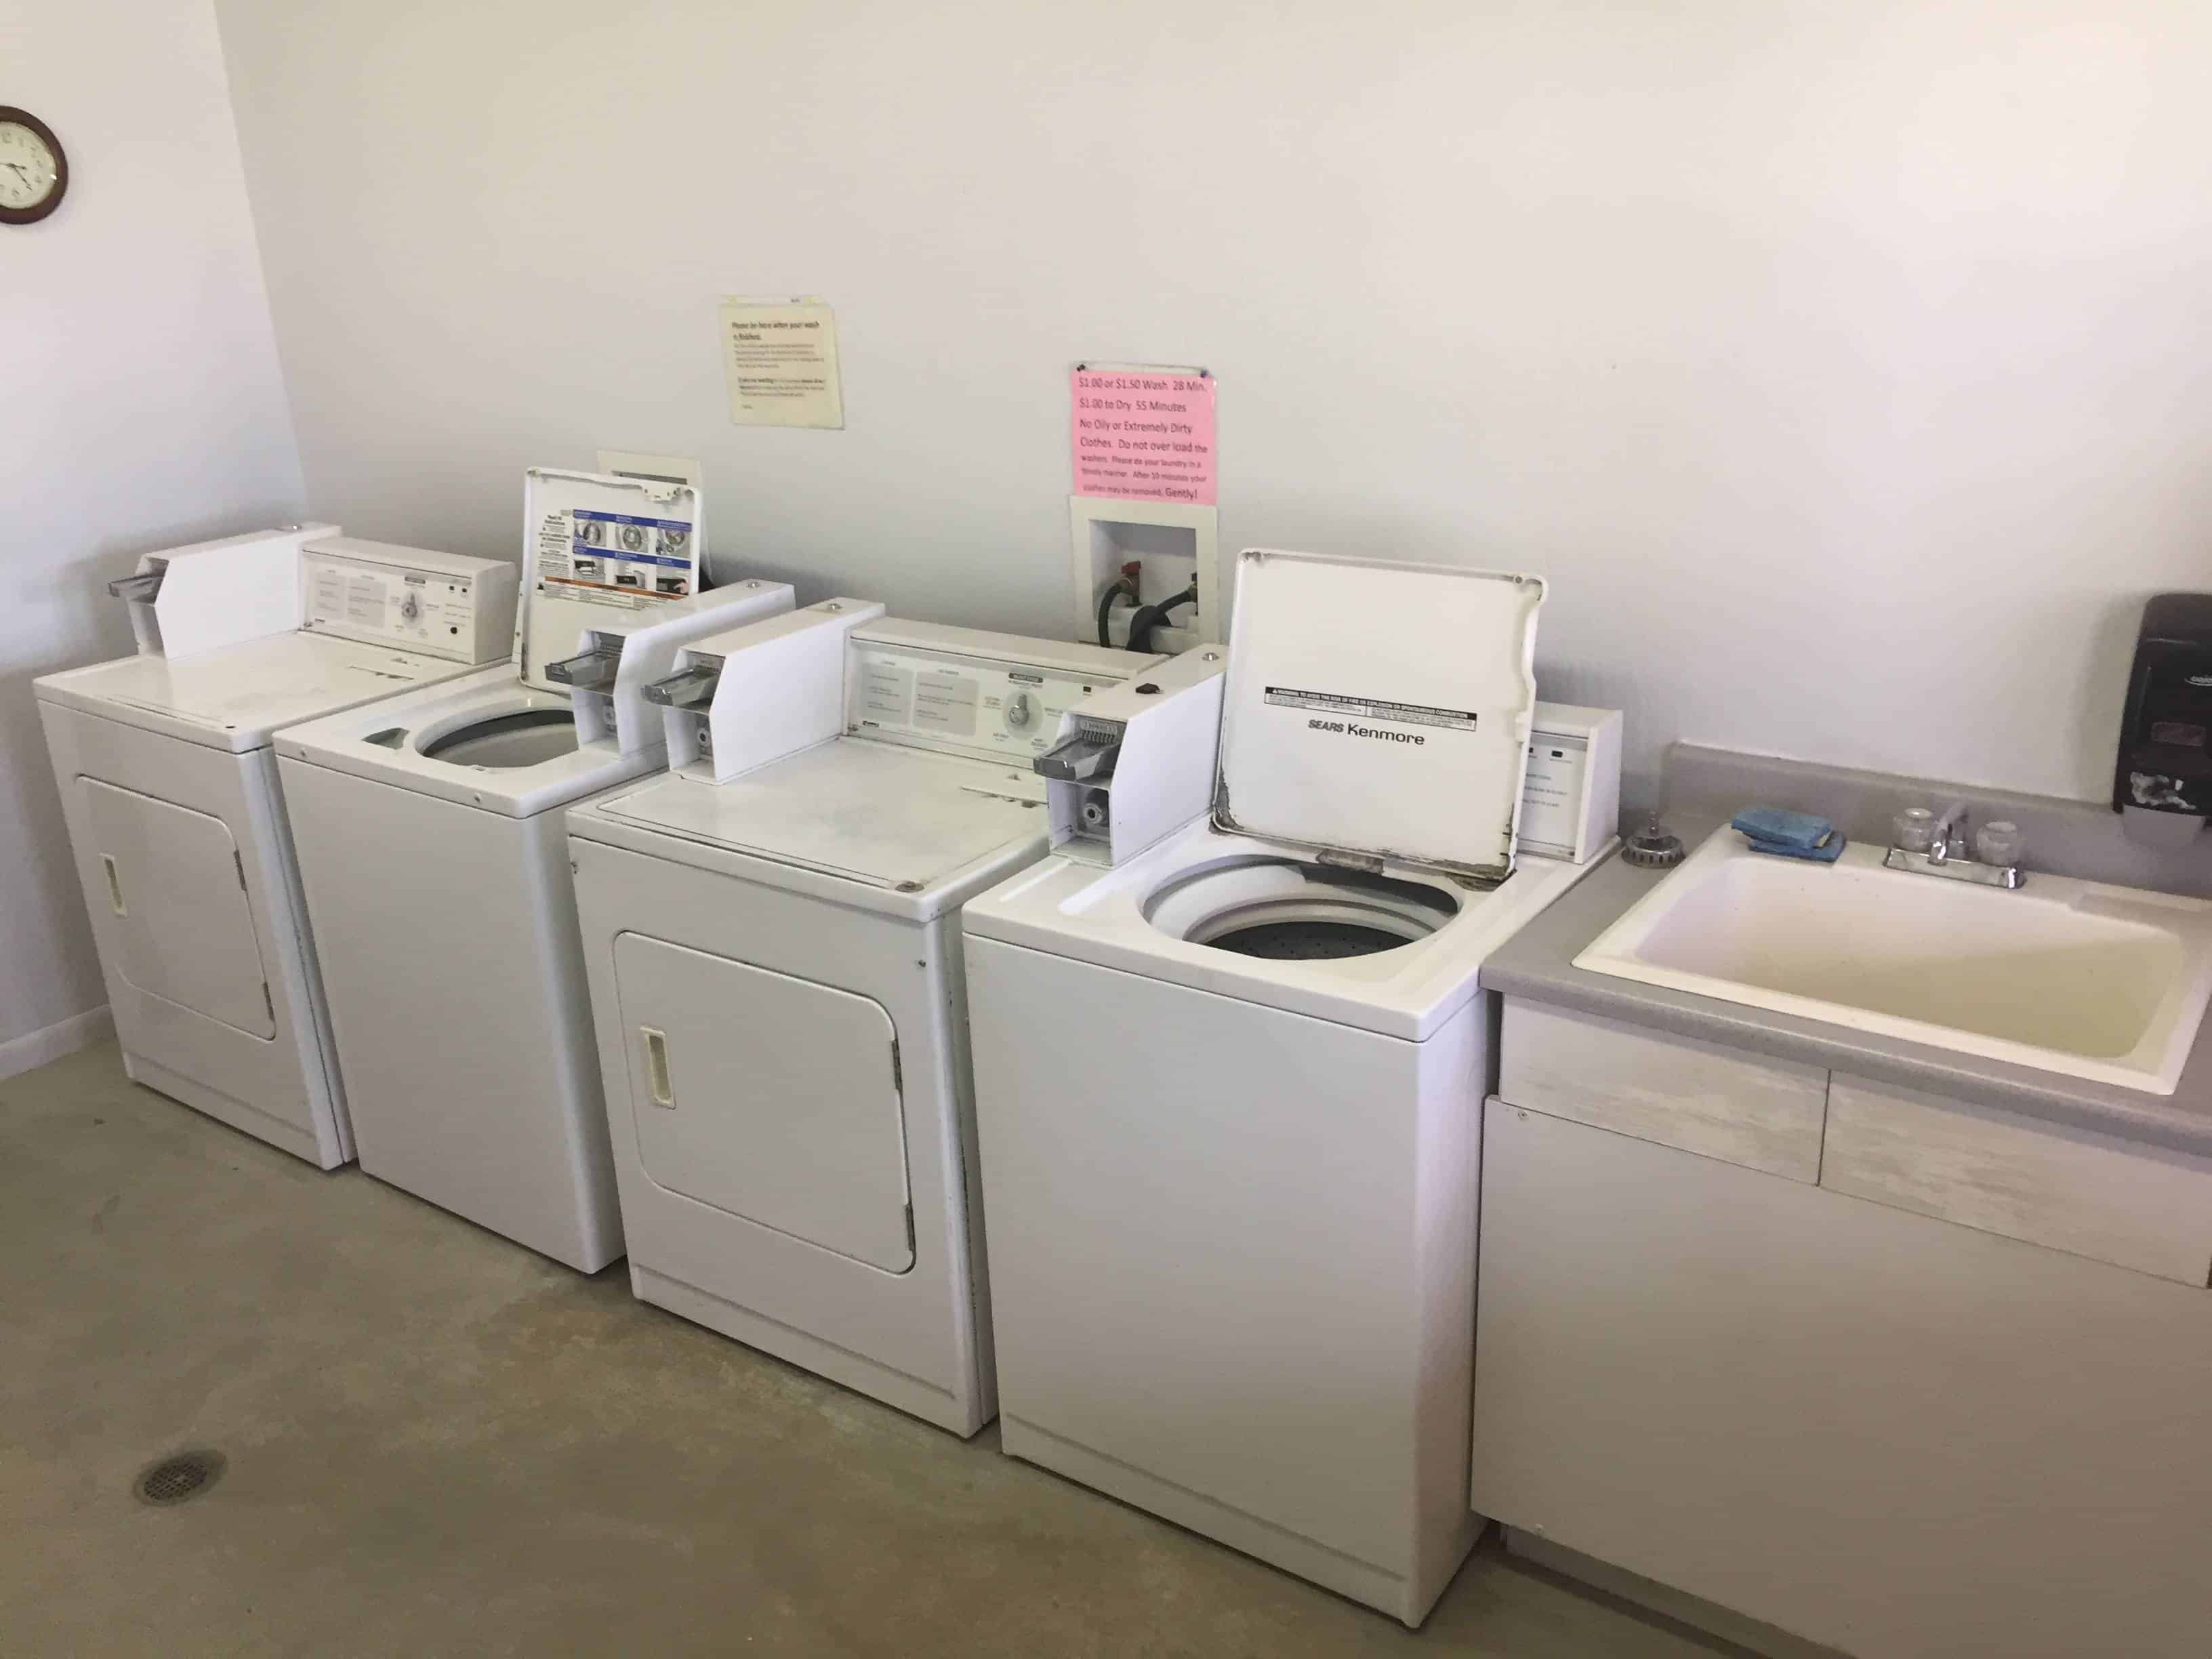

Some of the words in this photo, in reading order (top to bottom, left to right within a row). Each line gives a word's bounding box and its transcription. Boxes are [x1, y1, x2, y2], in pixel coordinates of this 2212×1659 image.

[1079, 377, 1103, 388] $1.00
[1116, 378, 1141, 390] $1.50
[1143, 380, 1168, 390] Wash
[1173, 381, 1184, 391] 28
[1187, 382, 1206, 392] Min.
[1080, 398, 1103, 409] $1.00
[1105, 401, 1114, 409] to
[1116, 400, 1132, 411] Dry
[1136, 401, 1147, 411] 55
[1150, 402, 1187, 413] Minutes
[1080, 419, 1091, 428] No
[1094, 419, 1110, 431] Oily
[1124, 422, 1168, 433] Extremely
[1171, 423, 1192, 435] Dirty
[1119, 439, 1130, 449] Do
[1133, 441, 1147, 450] not
[1173, 443, 1192, 453] load
[1195, 444, 1207, 453] the
[1112, 456, 1132, 464] Please
[1161, 459, 1186, 468] laundry
[1166, 487, 1197, 500] Gently!
[1308, 719, 1344, 733] SEARS
[1347, 723, 1425, 745] Kenmore
